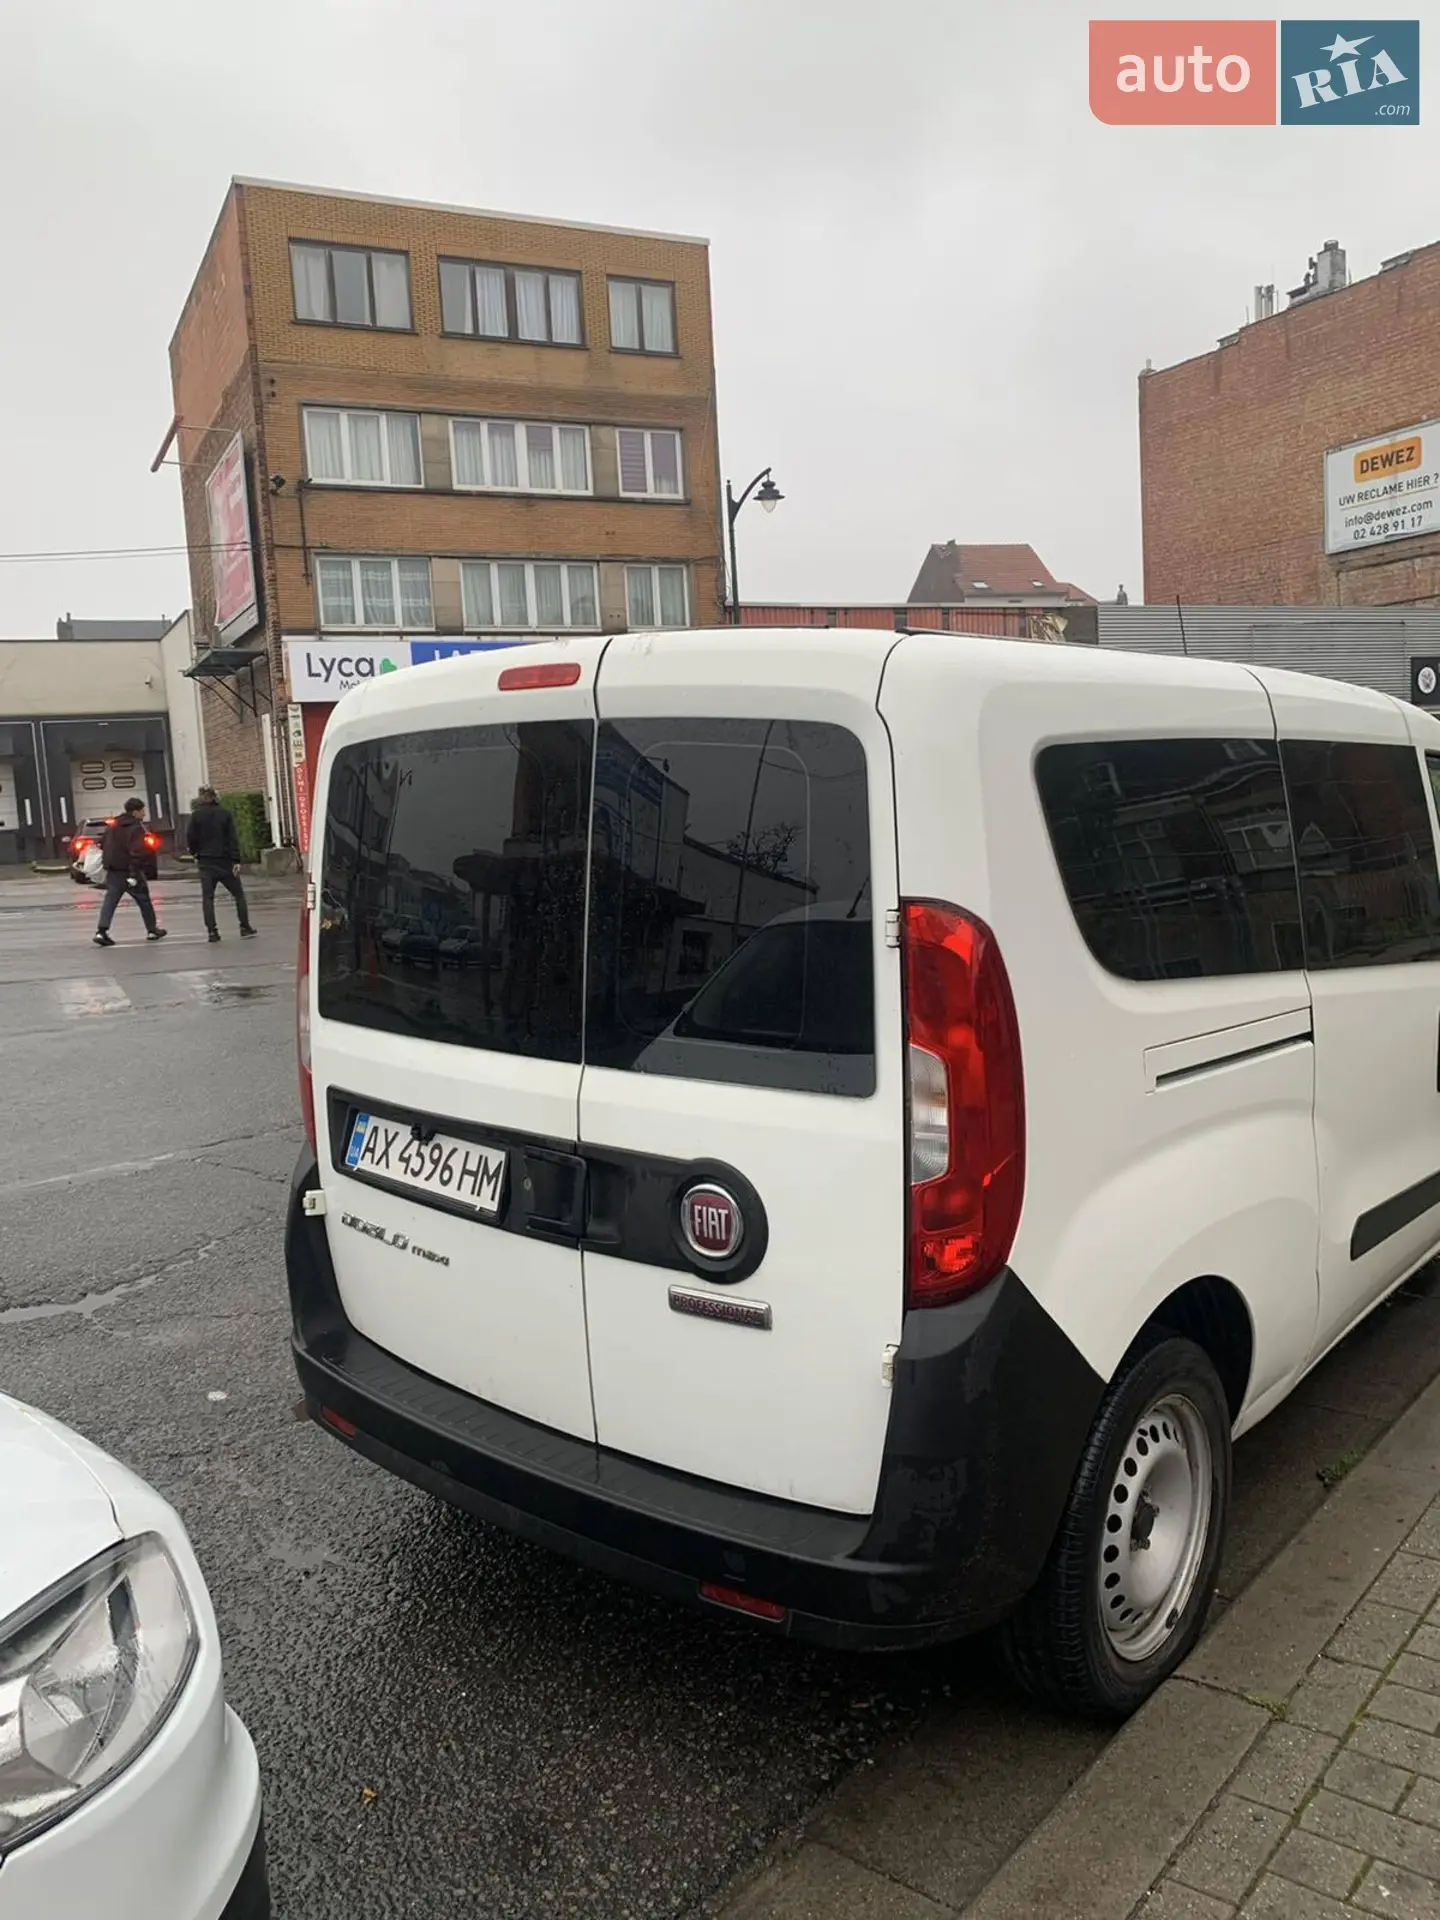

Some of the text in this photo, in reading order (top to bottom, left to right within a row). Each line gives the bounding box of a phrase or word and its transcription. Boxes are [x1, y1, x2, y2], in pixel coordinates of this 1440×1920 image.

[1360, 446, 1415, 474] DEWEZ
[1338, 493, 1356, 507] UW
[1357, 481, 1404, 502] RECLAME
[1406, 475, 1431, 490] HIER
[1344, 500, 1433, 527] info@dewez.com
[1353, 515, 1423, 540] 02 428 91 17
[305, 652, 375, 683] Lyca
[360, 1125, 503, 1202] AX 4596 HM
[693, 1204, 729, 1241] FIAT
[672, 1293, 762, 1325] PROFESSIONAL
